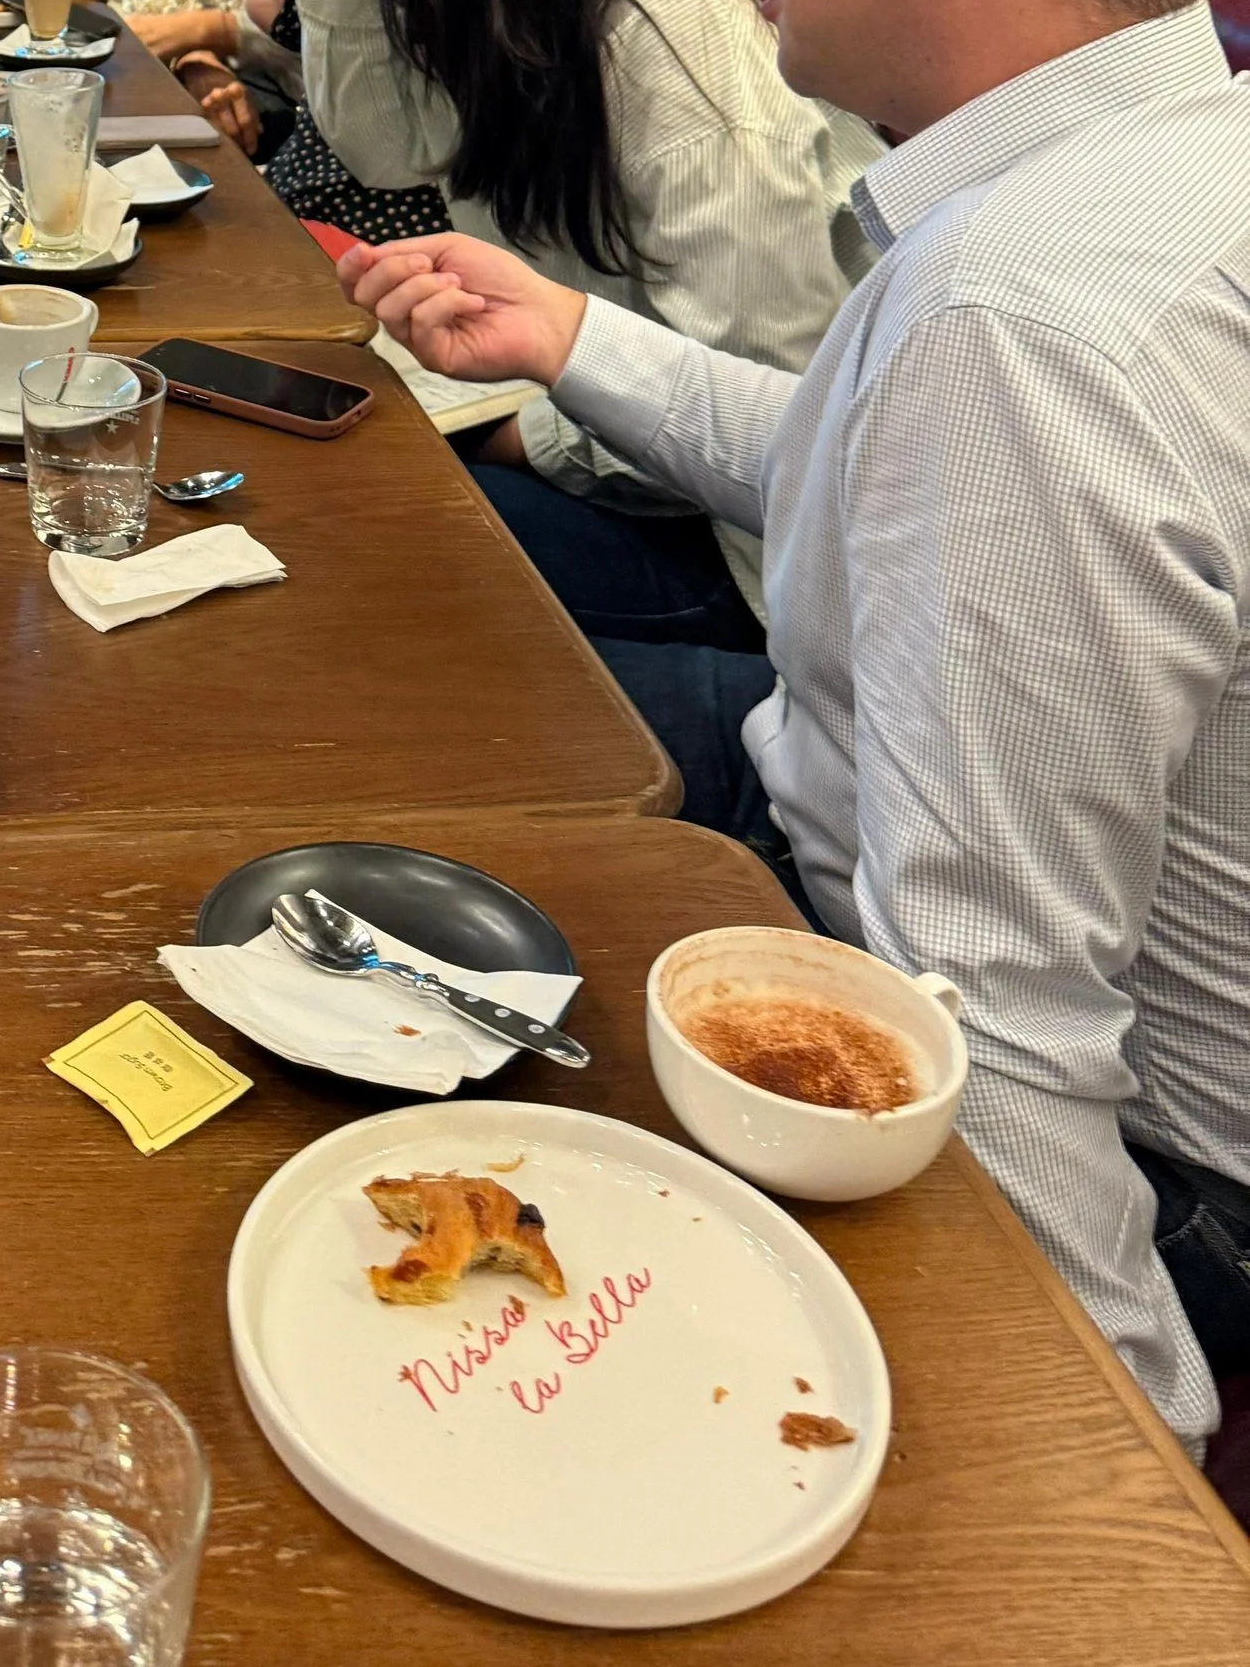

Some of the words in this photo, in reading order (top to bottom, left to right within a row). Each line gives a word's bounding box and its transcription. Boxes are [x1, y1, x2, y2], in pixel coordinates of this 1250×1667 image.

[403, 1300, 526, 1412] Nissa
[509, 1372, 562, 1414] la
[544, 1267, 651, 1364] Bella
